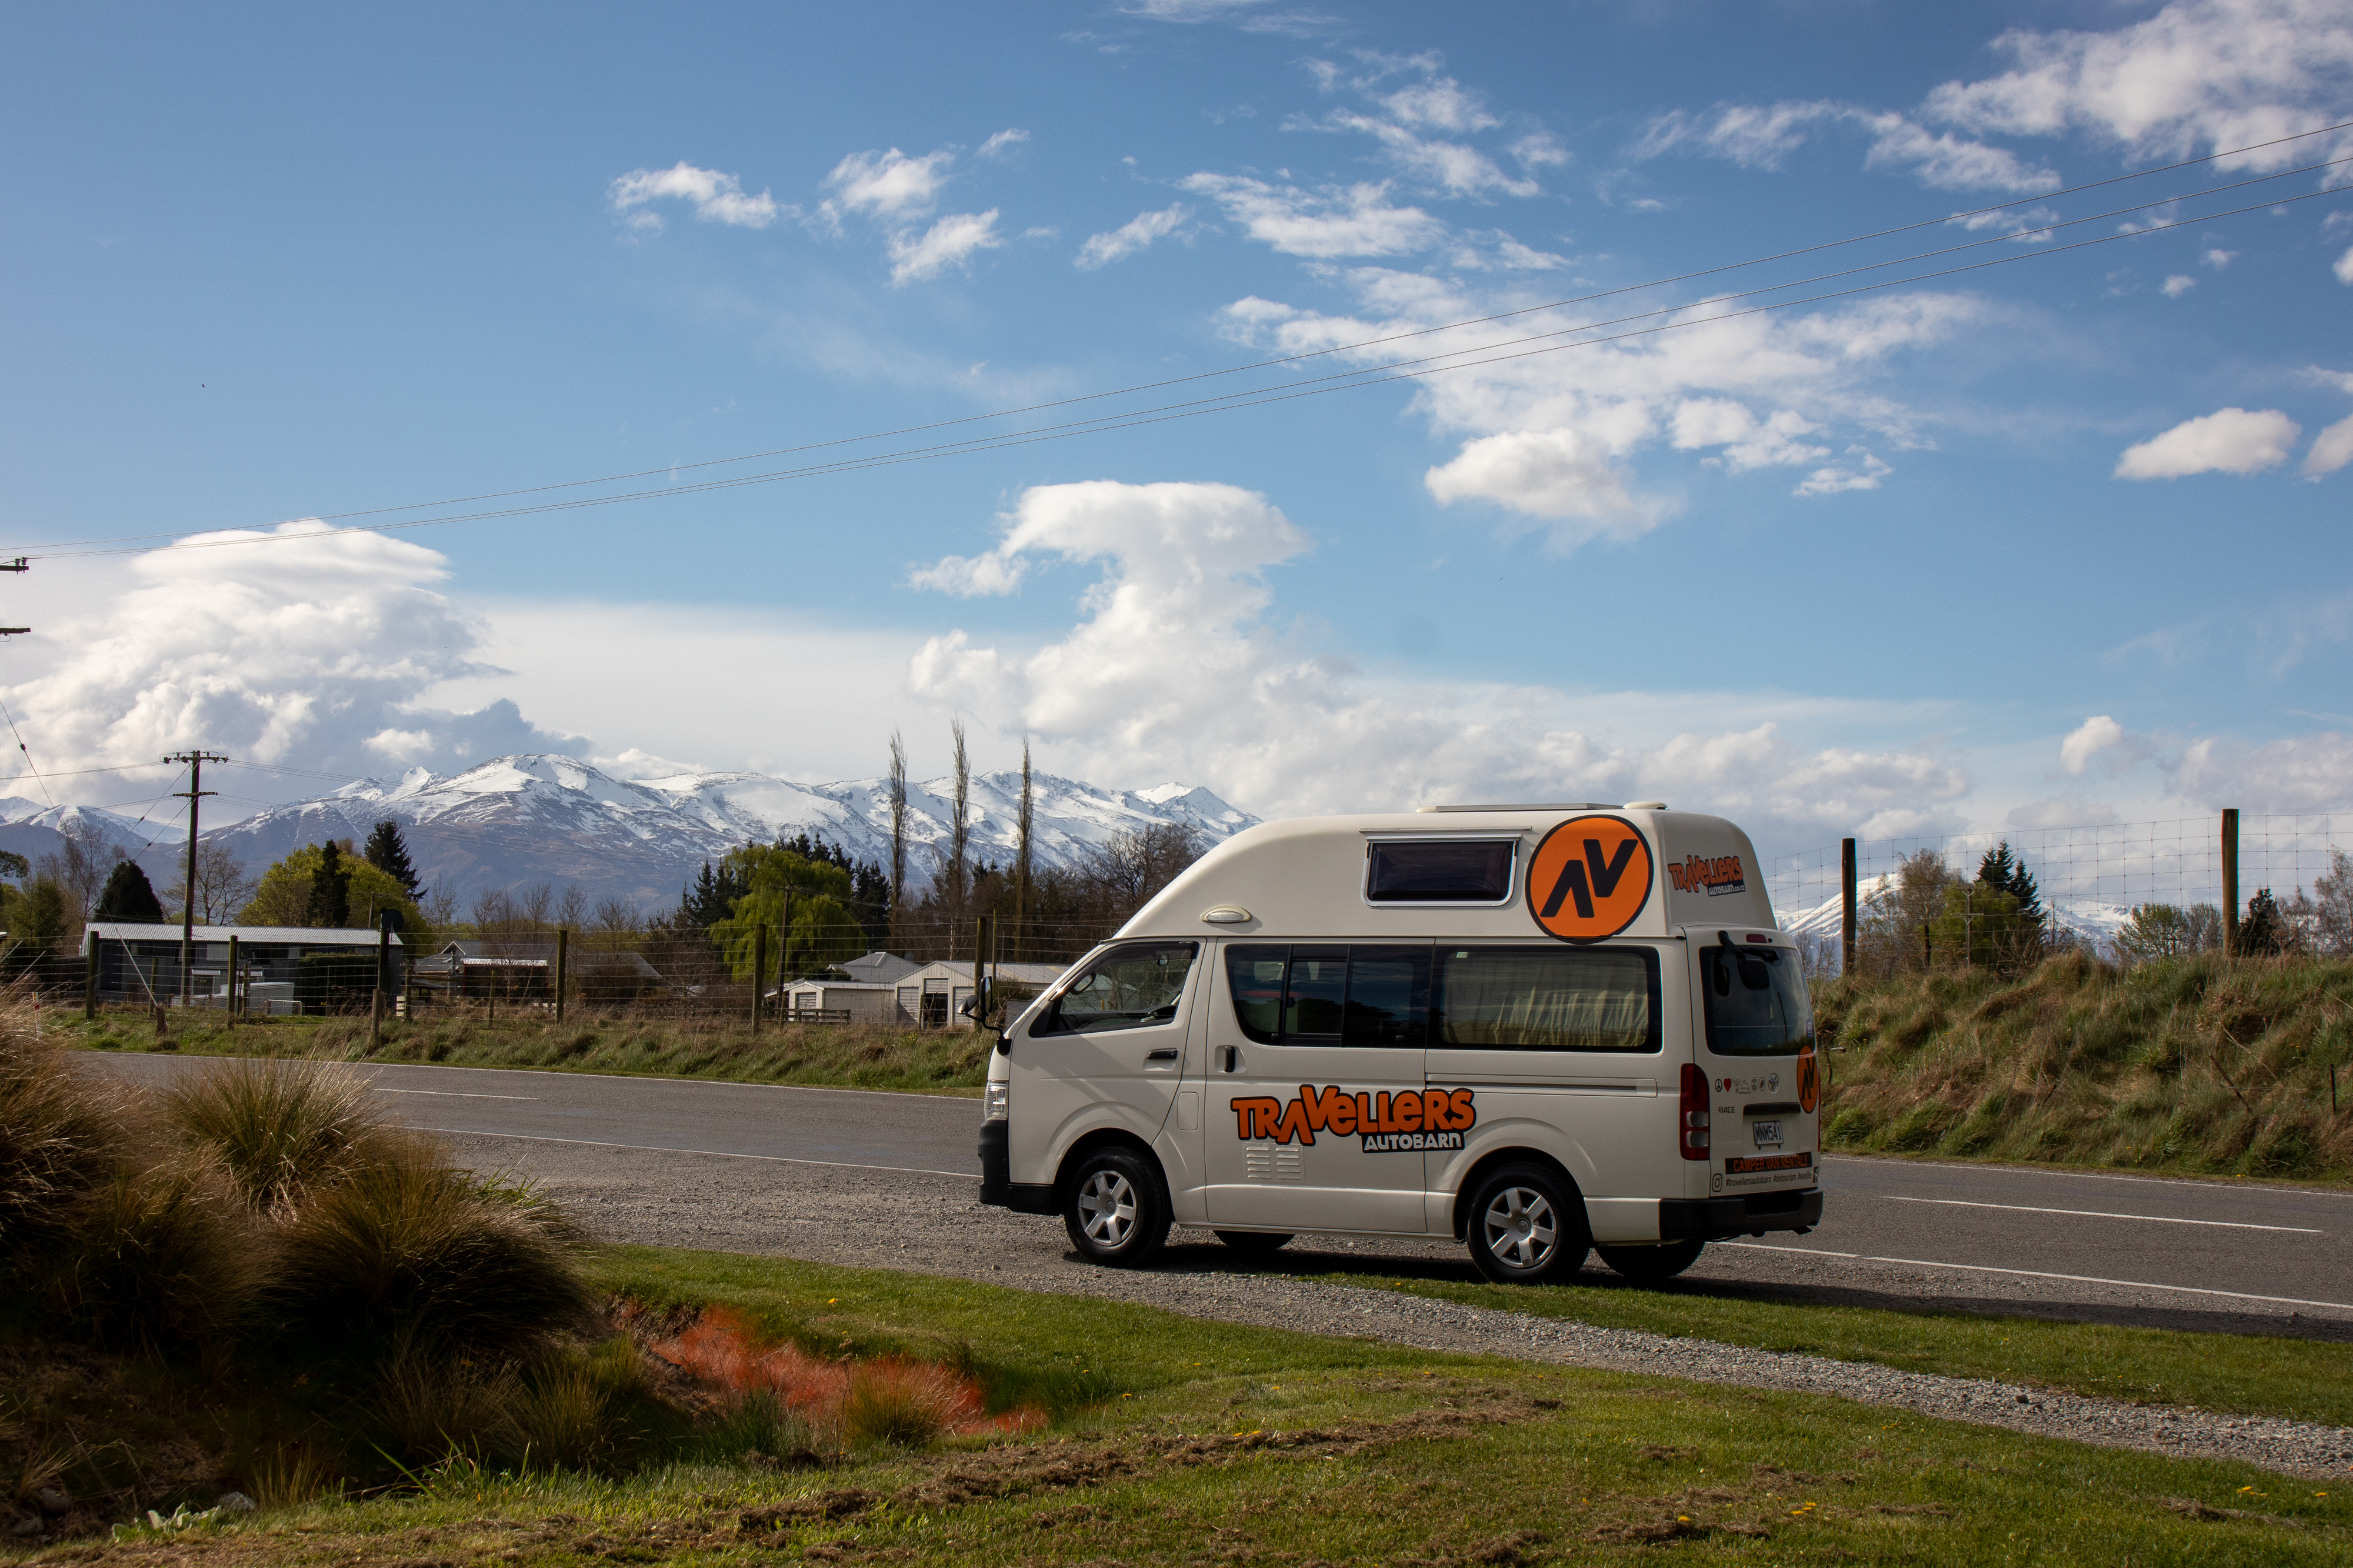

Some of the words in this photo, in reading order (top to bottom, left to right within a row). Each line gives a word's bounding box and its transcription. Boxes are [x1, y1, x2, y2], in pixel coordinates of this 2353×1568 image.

[1755, 1125, 1782, 1141] MNM541
[1734, 1158, 1764, 1172] CAMPER
[1765, 1157, 1780, 1169] VAN
[1781, 1155, 1808, 1168] RENTALS
[1725, 1176, 1772, 1186] #travellersautobarn
[1773, 1173, 1797, 1183] #detourism
